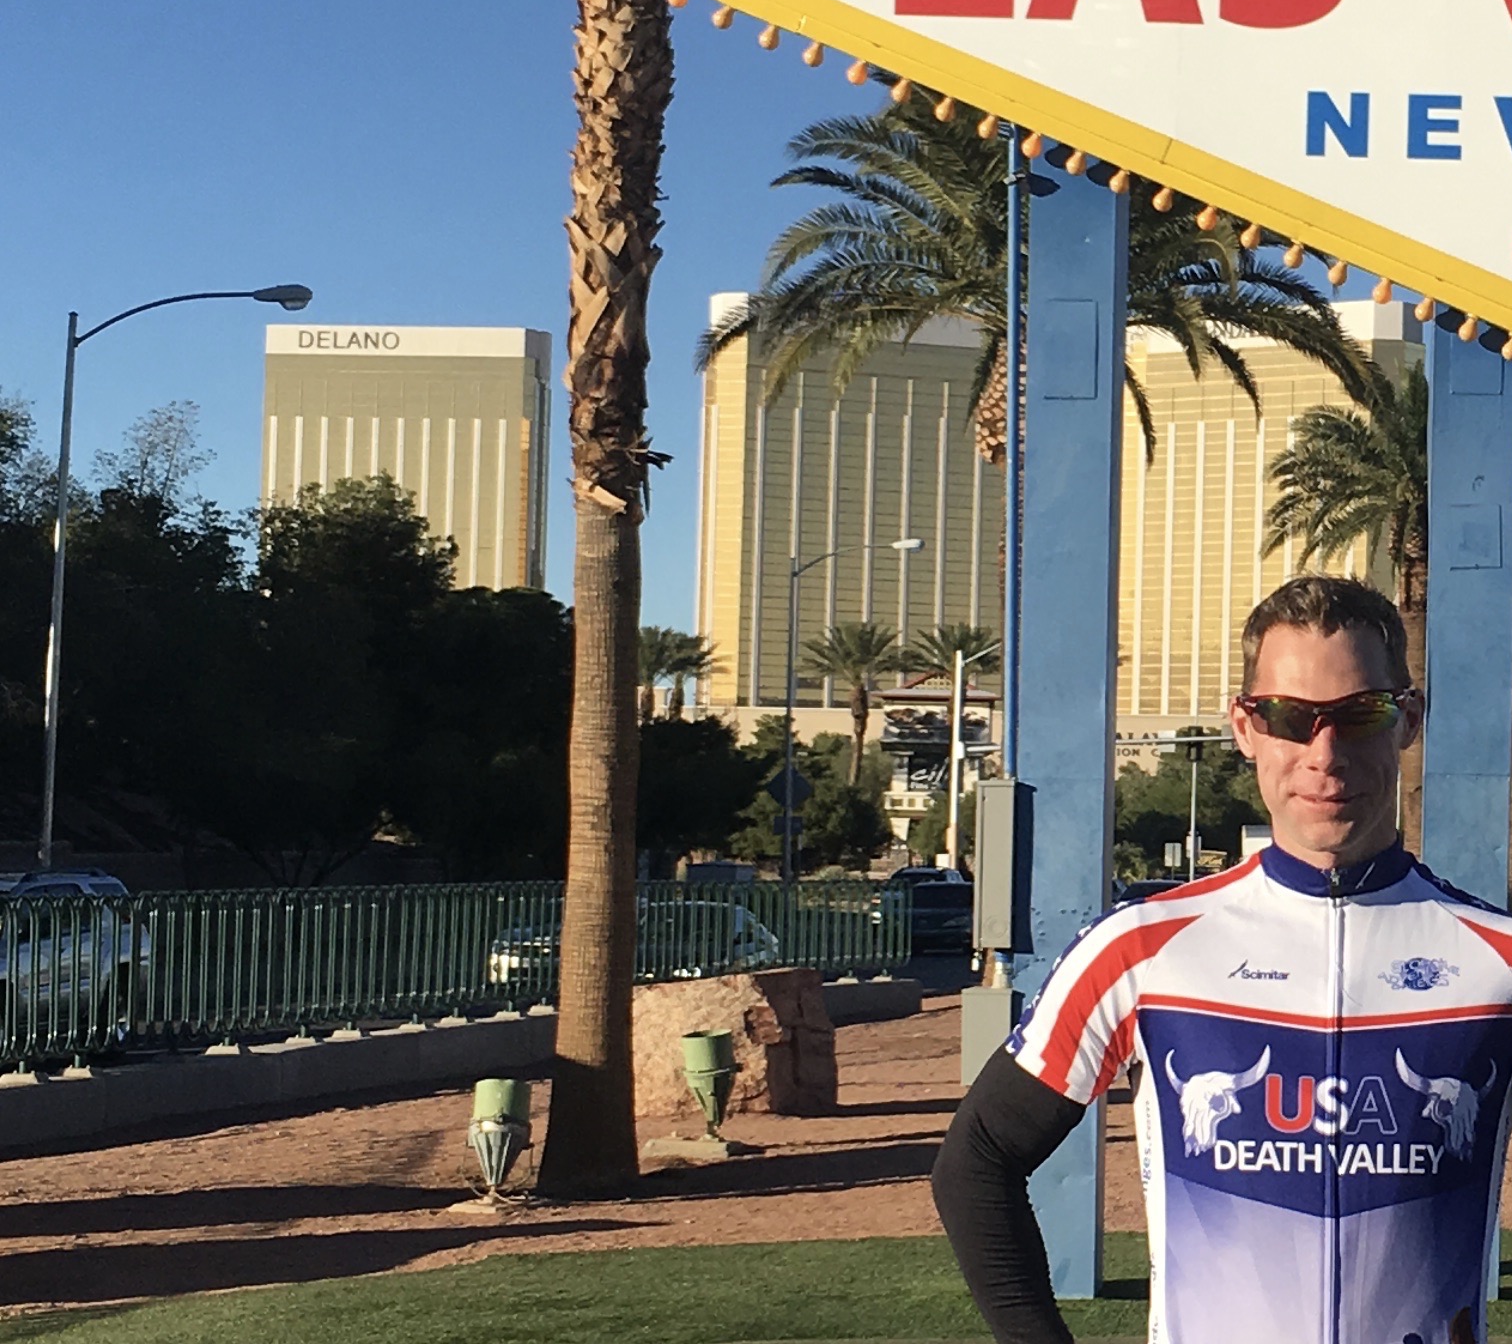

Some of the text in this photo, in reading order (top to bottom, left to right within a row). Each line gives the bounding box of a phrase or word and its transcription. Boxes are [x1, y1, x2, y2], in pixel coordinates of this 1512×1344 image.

[298, 330, 400, 350] DELANO
[1241, 968, 1290, 980] Scimitar
[1265, 1073, 1398, 1136] USA
[1214, 1140, 1444, 1176] DEATH VALLEY
